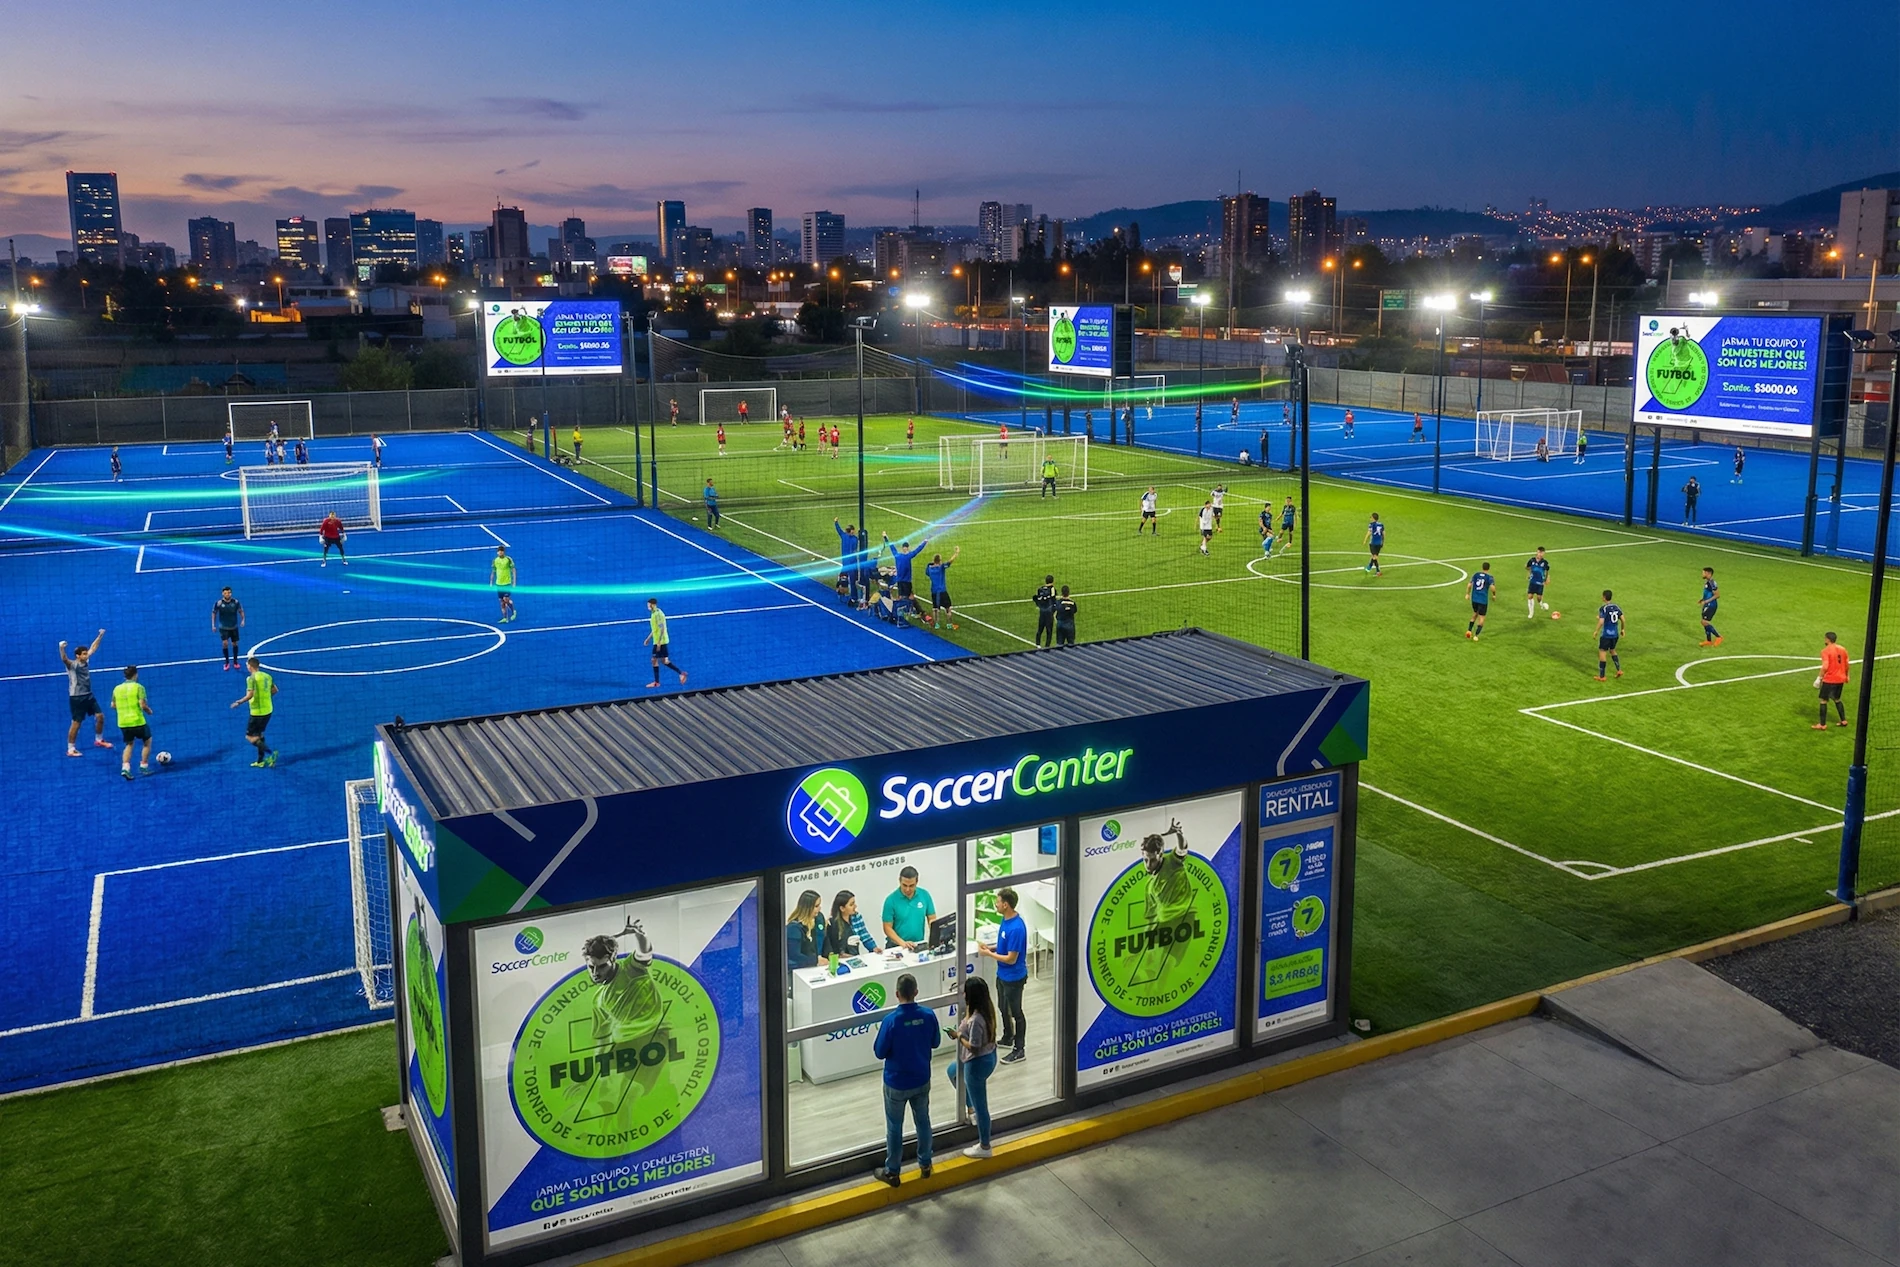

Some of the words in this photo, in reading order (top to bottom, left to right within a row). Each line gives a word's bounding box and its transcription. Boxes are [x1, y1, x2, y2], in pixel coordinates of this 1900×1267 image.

[1752, 338, 1763, 346] TU
[1765, 338, 1798, 348] EQUIPO
[1800, 339, 1807, 348] Y
[1784, 350, 1805, 360] QUE
[1656, 369, 1697, 381] FUTBOL
[1717, 358, 1736, 367] SON
[1739, 358, 1758, 368] LOS
[879, 747, 1134, 820] SoccerCenter
[1266, 789, 1334, 818] RENTAL
[1280, 858, 1291, 877] 7
[1301, 907, 1314, 924] 7
[1114, 919, 1206, 958] FUTBOL
[490, 950, 570, 974] SoccerCenter
[1135, 989, 1178, 1007] TORNEO
[694, 1012, 710, 1033] DE
[528, 1027, 547, 1050] DE
[1094, 1045, 1119, 1060] QUE
[1121, 1038, 1145, 1053] SON
[1148, 1032, 1169, 1046] LOS
[1172, 1017, 1222, 1039] MEJORES!
[550, 1037, 686, 1090] FUTBOL
[524, 1065, 554, 1126] TORNEO
[551, 1122, 573, 1140] DE
[586, 1125, 650, 1148] TORNEO
[653, 1110, 674, 1128] DE
[530, 1192, 565, 1212] QUE
[569, 1182, 605, 1202] SON
[608, 1174, 640, 1192] LOS
[644, 1153, 716, 1184] MEJORES!
[572, 1176, 588, 1188] TU
[591, 1166, 630, 1184] EQUIPO
[632, 1164, 640, 1172] Y
